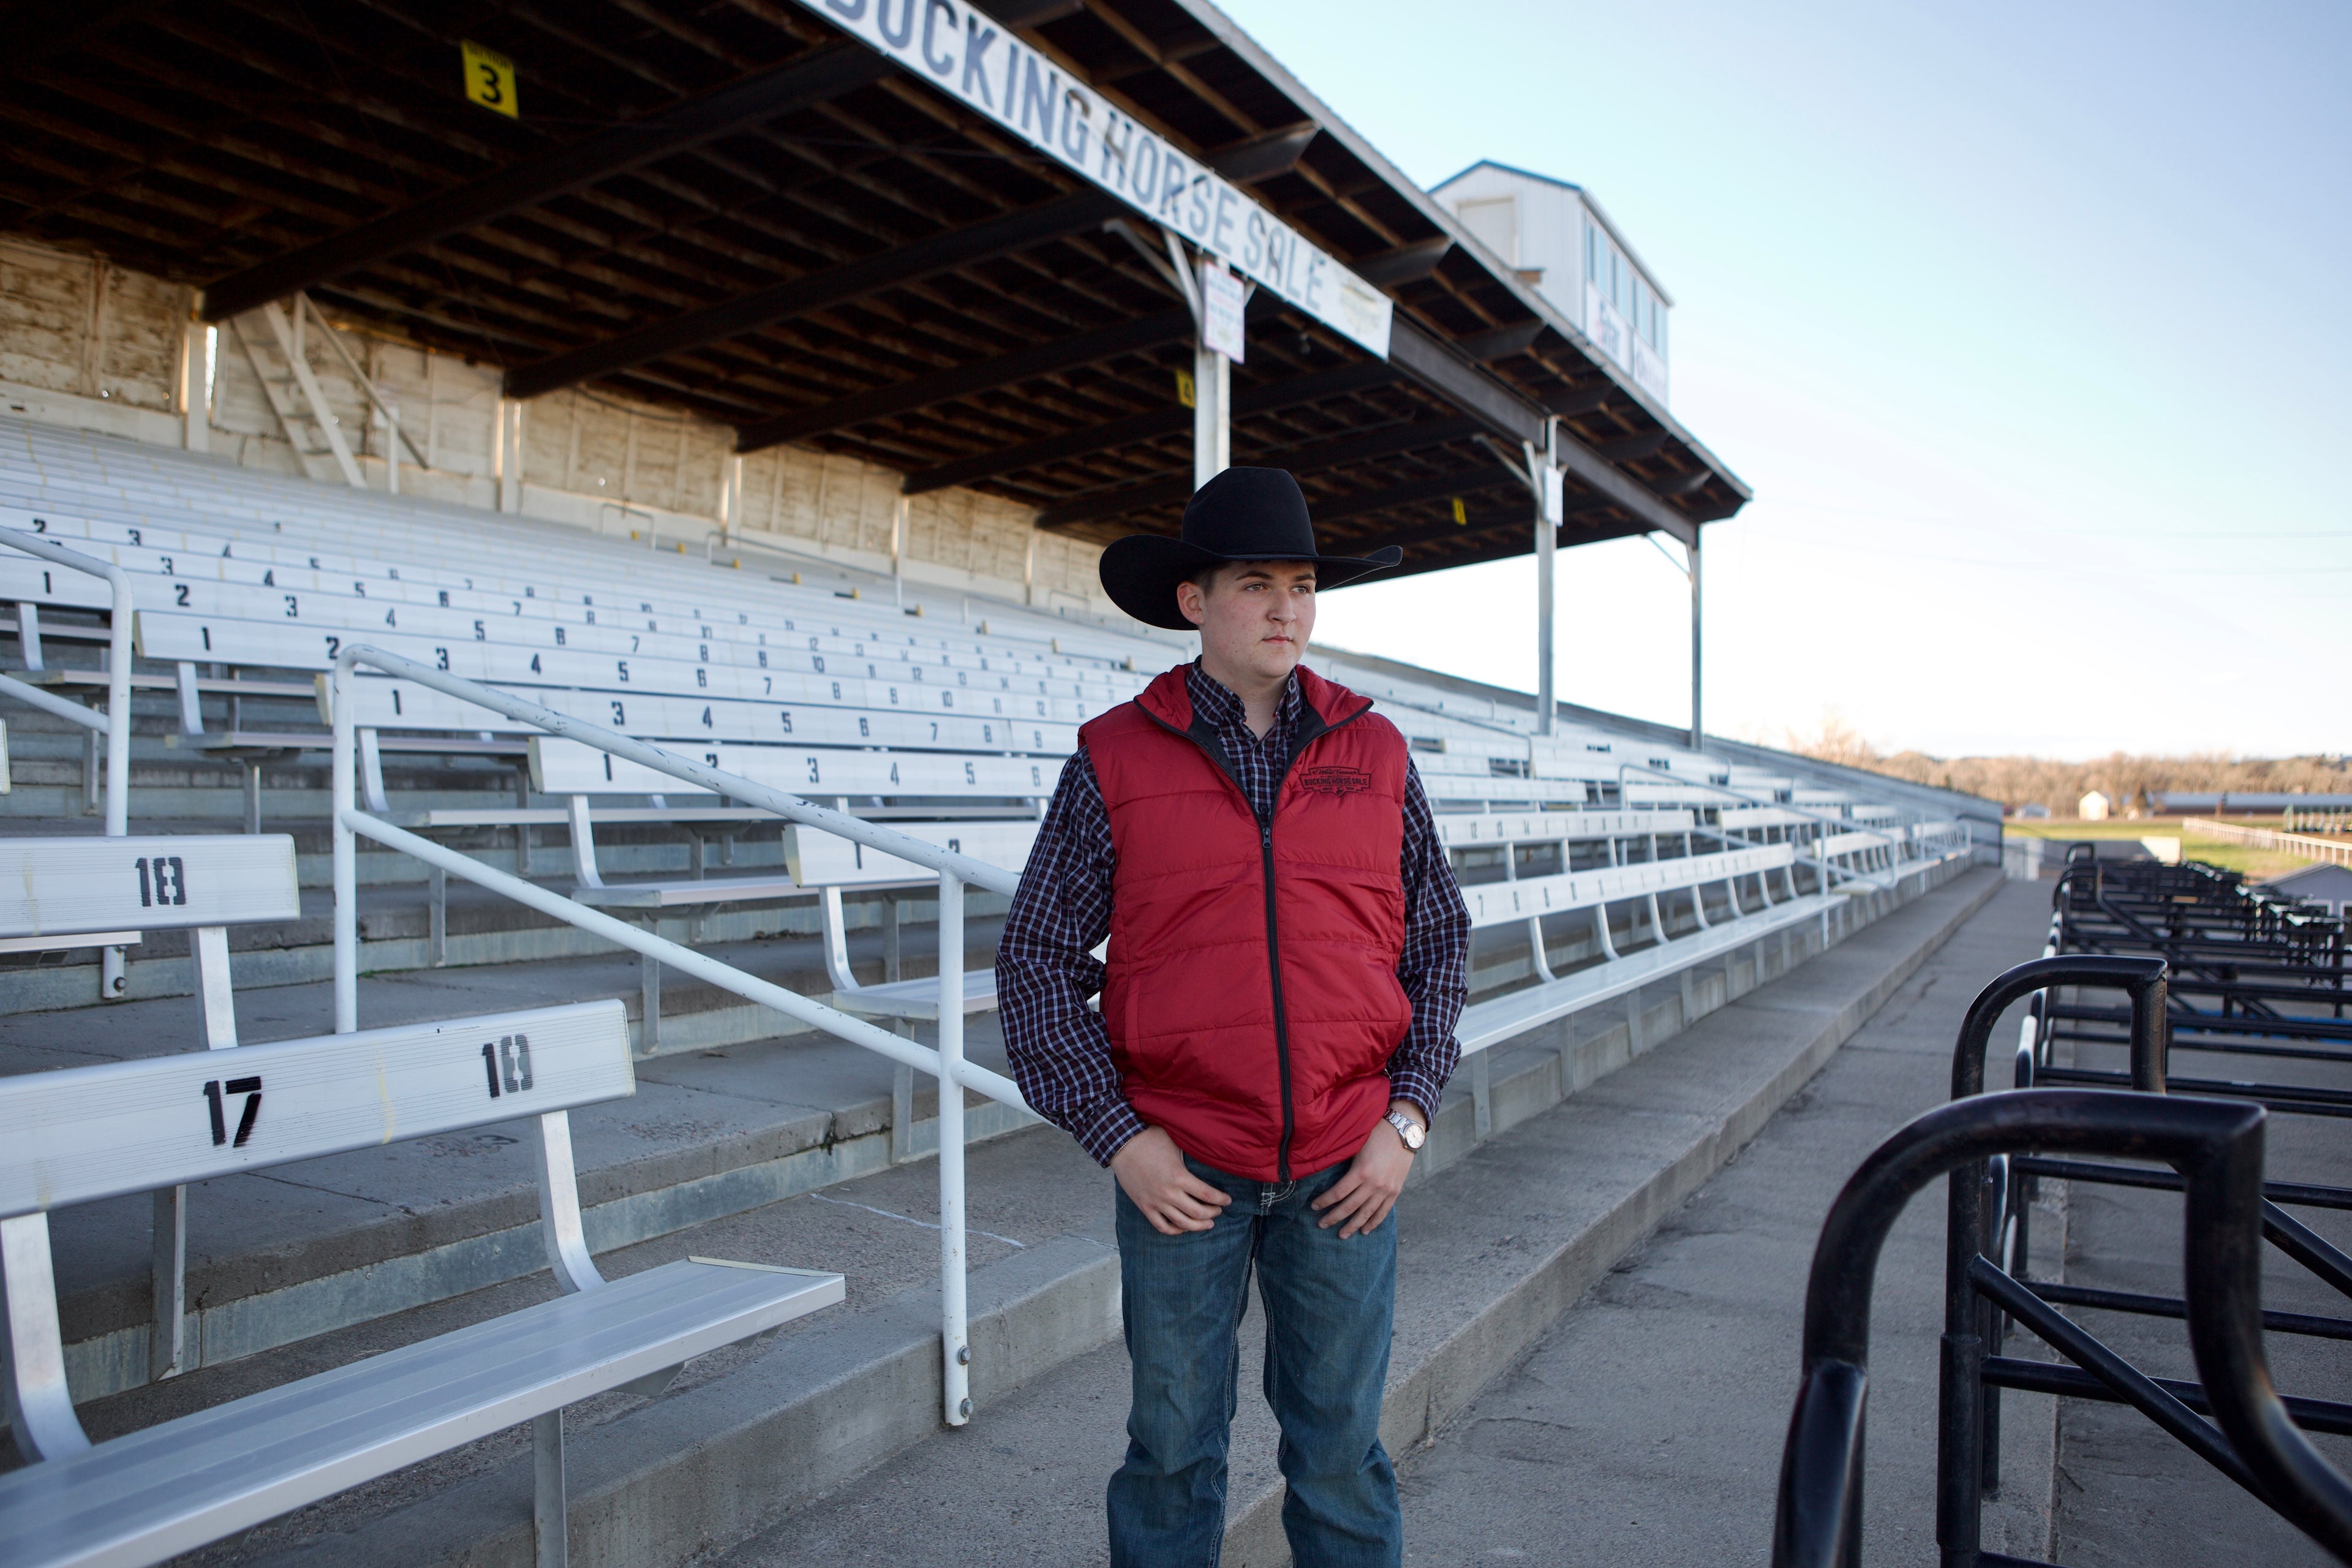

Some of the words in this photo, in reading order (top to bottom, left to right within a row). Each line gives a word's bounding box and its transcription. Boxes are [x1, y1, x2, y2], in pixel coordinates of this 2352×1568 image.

[480, 64, 502, 104] 3
[1102, 111, 1238, 255] HORSE
[1244, 208, 1327, 312] SALE
[35, 519, 45, 532] 2
[129, 529, 141, 545] 3
[222, 543, 231, 557] 4
[161, 557, 173, 575] 3
[264, 570, 274, 586] 4
[355, 582, 366, 598] 5
[514, 601, 522, 616] 7
[43, 571, 50, 594] 1
[175, 584, 189, 606] 2
[285, 595, 297, 617] 3
[386, 608, 395, 627] 4
[475, 620, 485, 641] 5
[632, 636, 639, 652] 7
[812, 655, 824, 672] 10
[913, 667, 922, 680] 12
[202, 627, 210, 650] 1
[326, 637, 339, 659] 2
[437, 648, 449, 670] 3
[531, 654, 541, 674] 4
[619, 662, 628, 681] 5
[764, 677, 771, 694] 7
[943, 691, 952, 707] 10
[994, 698, 1001, 713] 11
[1037, 701, 1045, 716] 12
[393, 689, 401, 715] 1
[612, 702, 624, 725] 3
[703, 707, 712, 728] 4
[782, 712, 791, 733] 5
[860, 718, 869, 736] 6
[931, 723, 937, 740] 7
[984, 725, 991, 742] 8
[604, 753, 612, 781] 1
[807, 758, 819, 783] 3
[891, 763, 899, 785] 4
[965, 763, 974, 784] 5
[135, 858, 186, 906] 18
[203, 1076, 261, 1147] 17
[483, 1034, 533, 1098] 18
